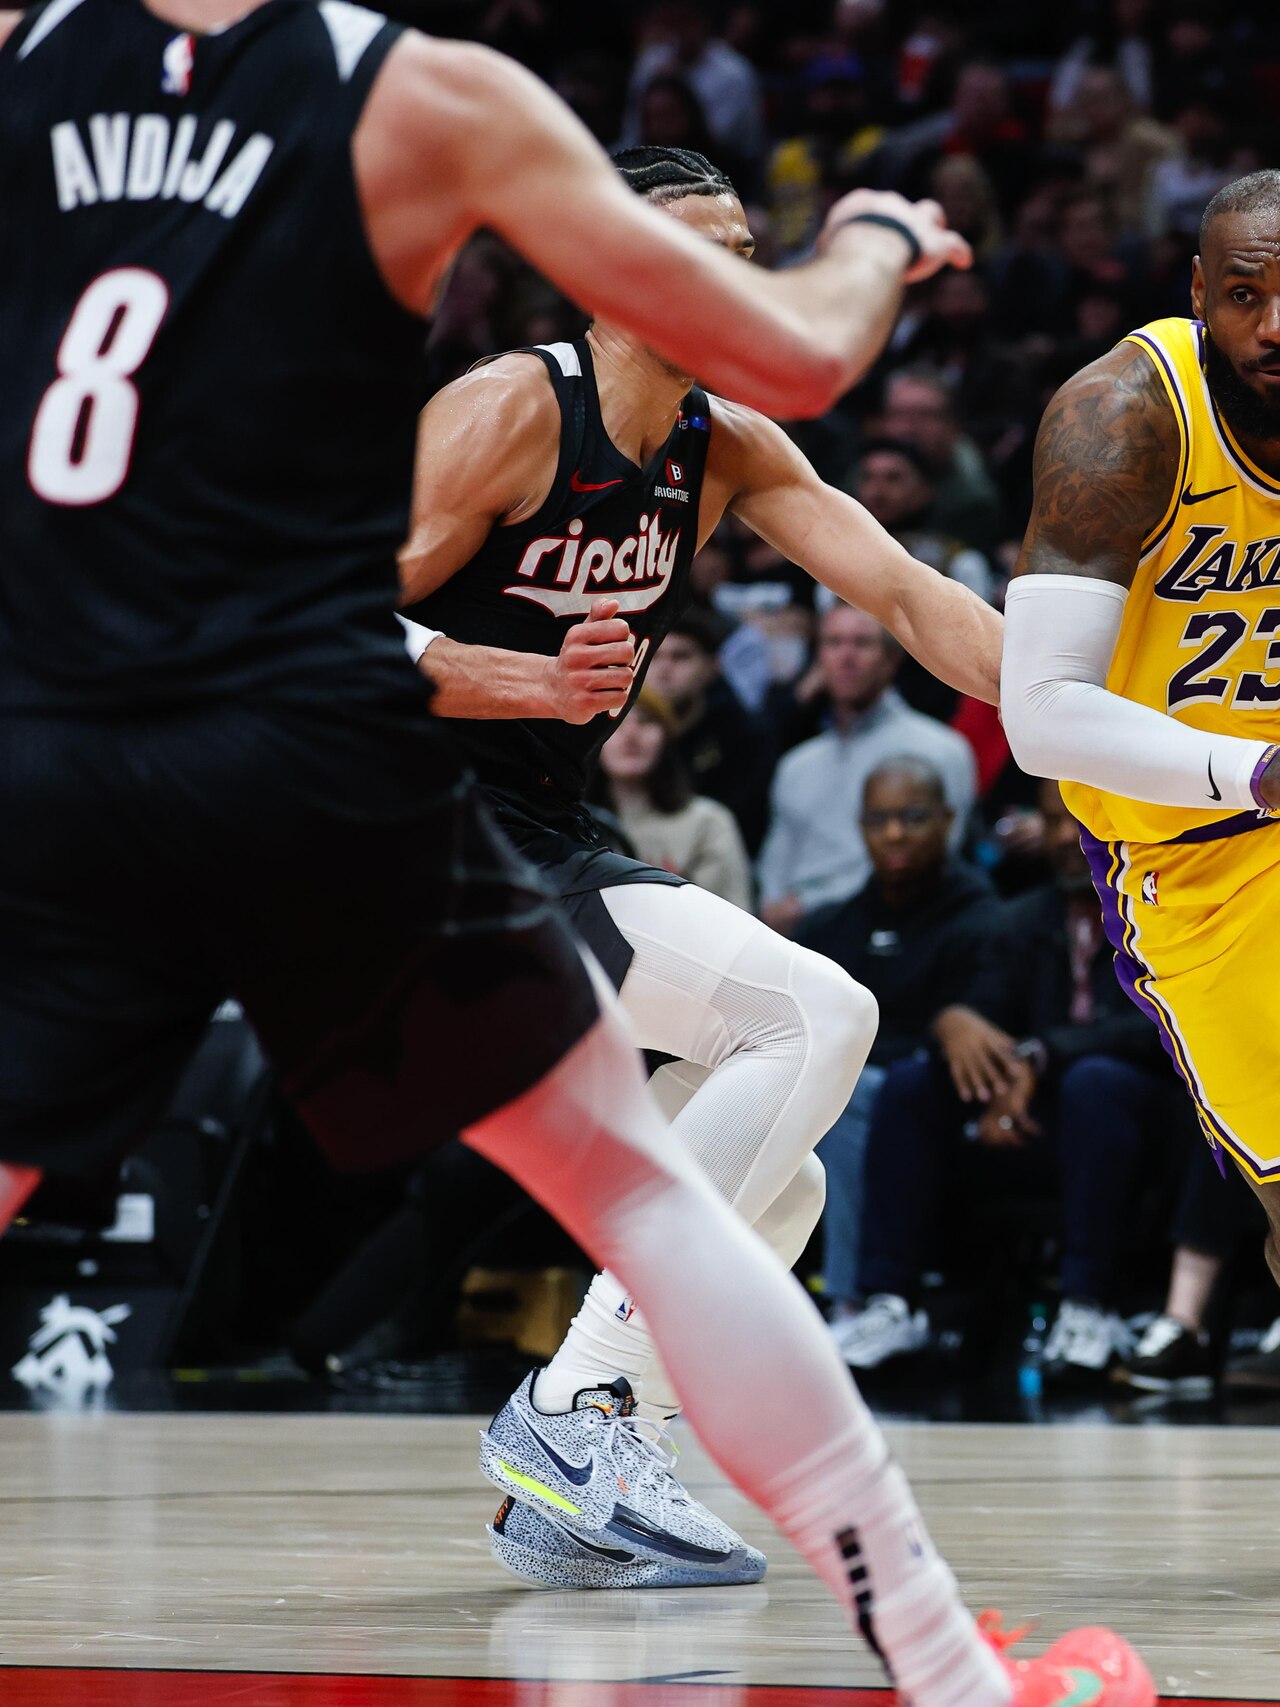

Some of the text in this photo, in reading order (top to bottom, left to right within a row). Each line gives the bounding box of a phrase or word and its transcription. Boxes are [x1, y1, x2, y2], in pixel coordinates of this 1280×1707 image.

[50, 111, 275, 219] AVDIJA
[27, 265, 170, 506] 8
[671, 463, 682, 481] B
